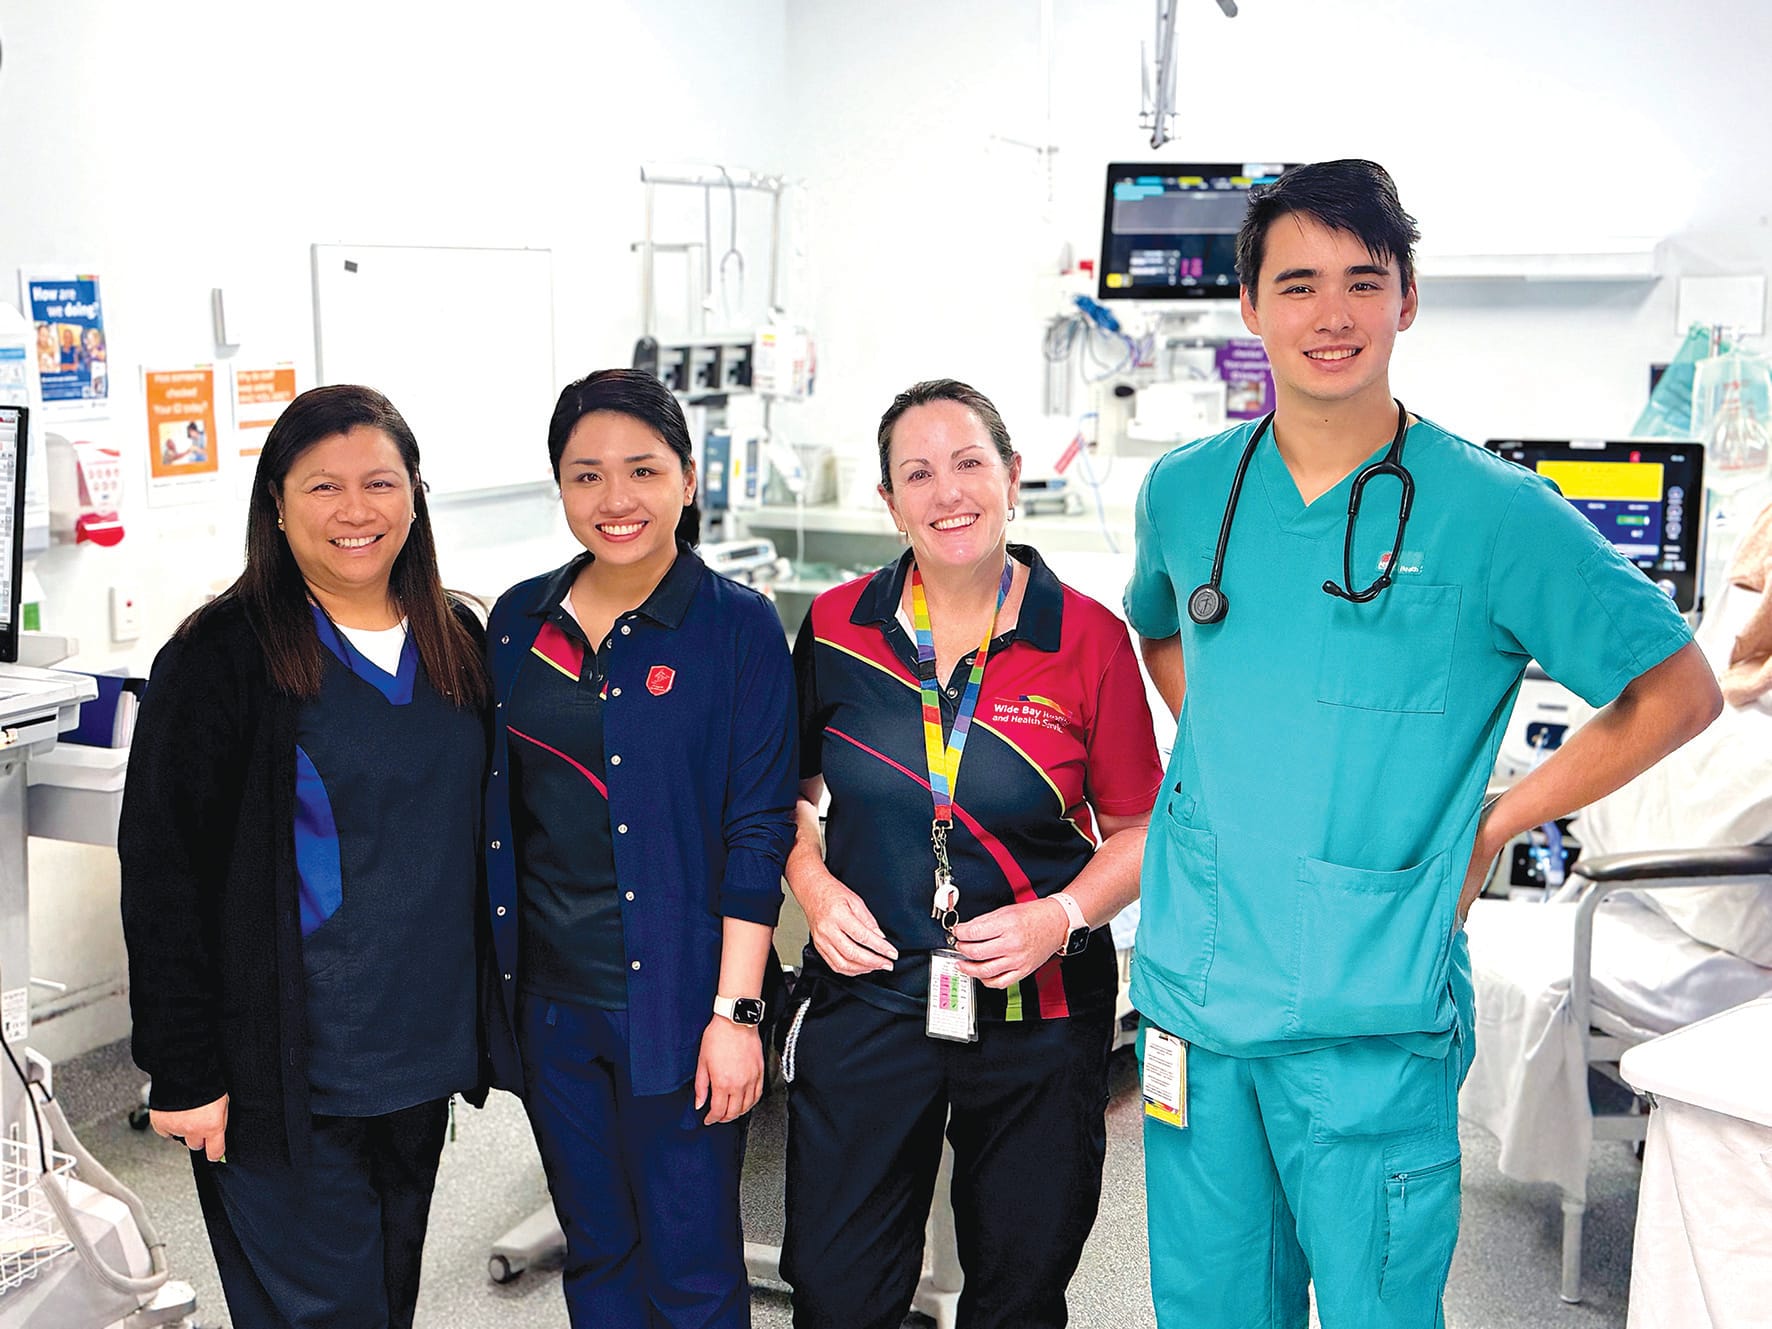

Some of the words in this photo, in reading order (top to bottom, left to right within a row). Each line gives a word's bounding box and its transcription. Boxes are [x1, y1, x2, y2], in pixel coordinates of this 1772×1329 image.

[32, 286, 58, 302] How
[59, 288, 76, 301] are
[994, 703, 1019, 714] Wide
[1022, 705, 1041, 718] Bay
[1011, 715, 1040, 725] Health
